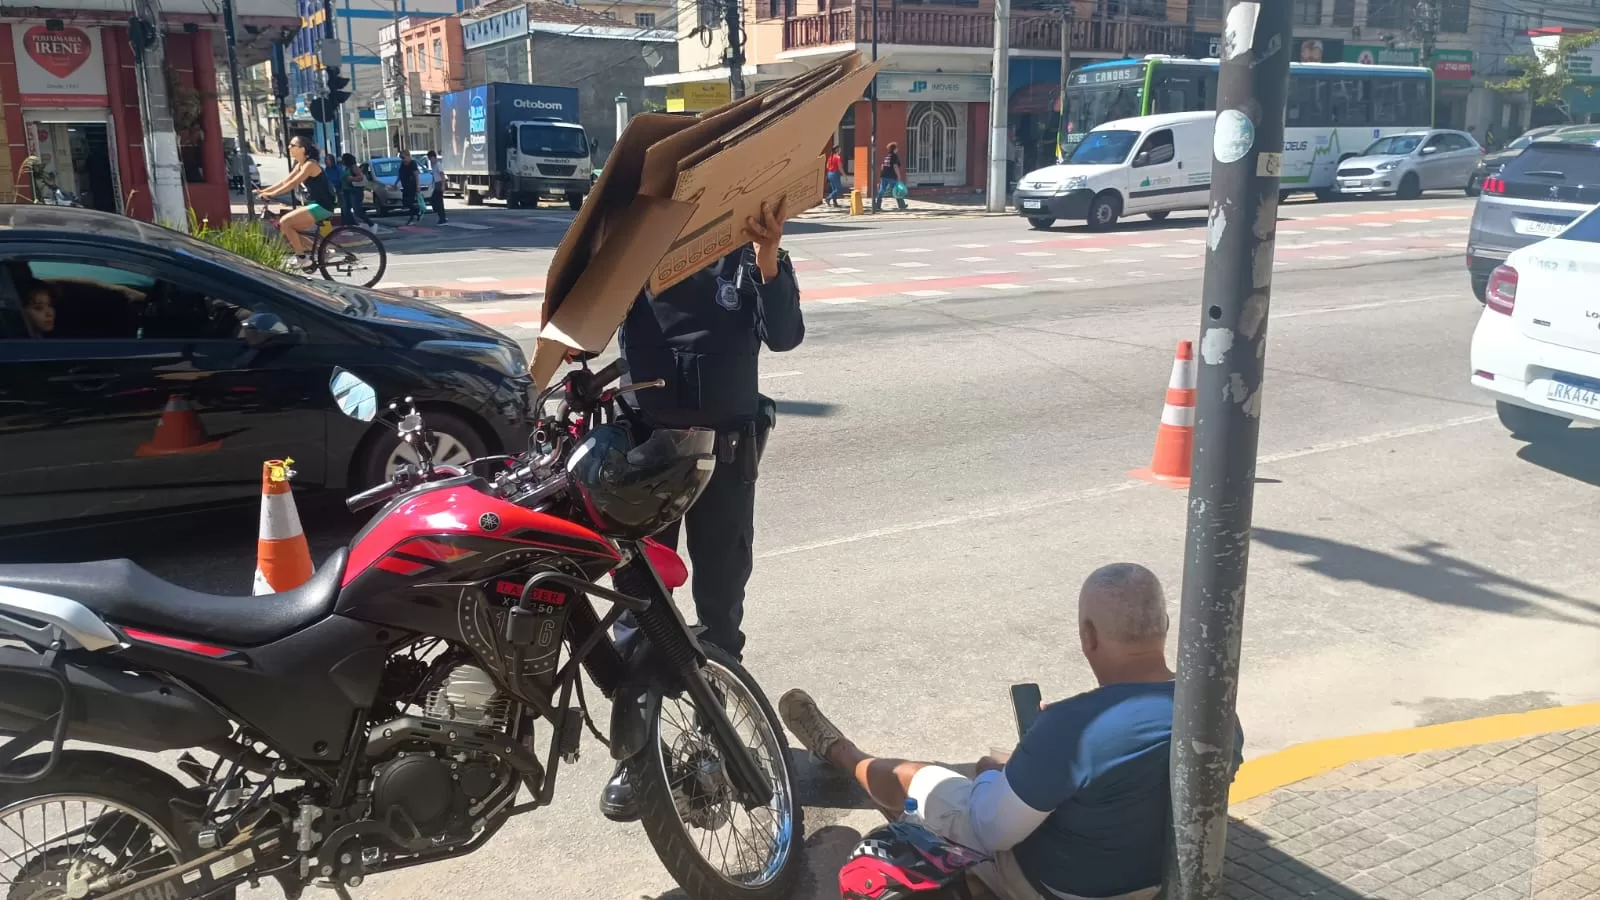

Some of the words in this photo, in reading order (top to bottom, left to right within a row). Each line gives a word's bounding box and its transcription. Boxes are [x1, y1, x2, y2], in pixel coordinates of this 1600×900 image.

[35, 42, 82, 54] IRENE
[908, 81, 928, 93] JP
[513, 98, 562, 110] Ortobom
[1585, 310, 1600, 319] LO
[502, 584, 558, 600] LADER
